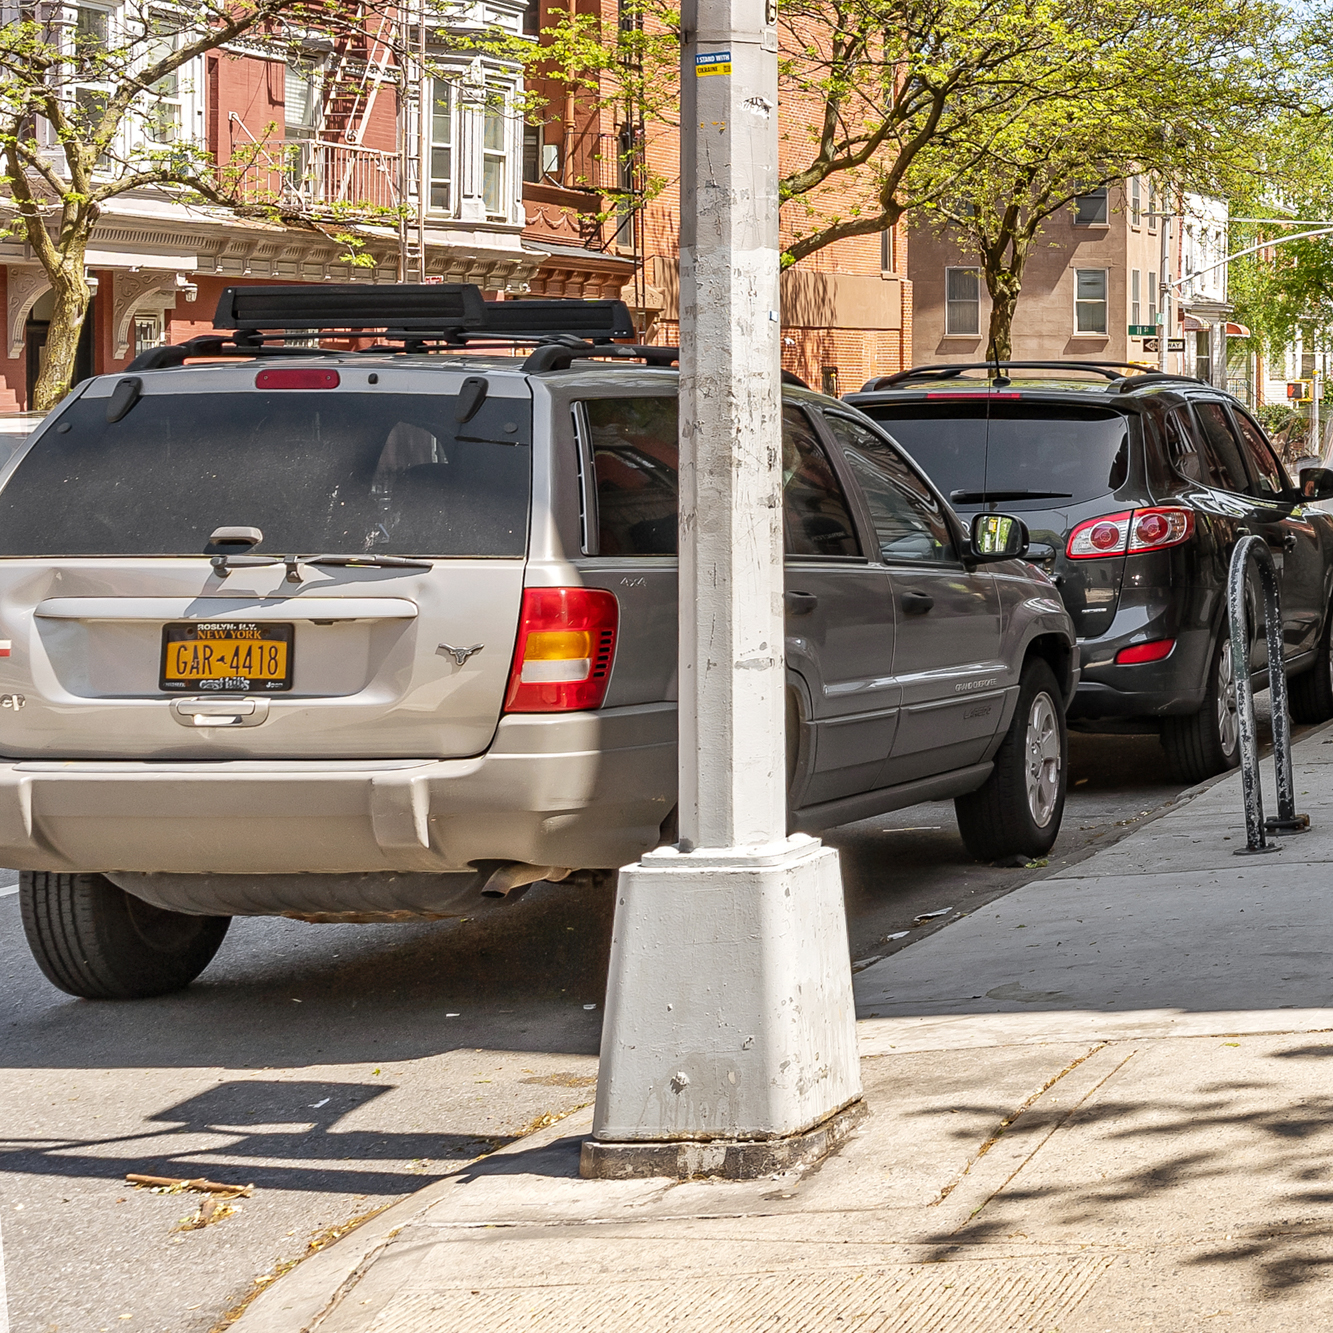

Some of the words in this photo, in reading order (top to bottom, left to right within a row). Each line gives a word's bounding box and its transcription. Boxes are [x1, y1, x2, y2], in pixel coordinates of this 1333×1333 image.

[197, 630, 227, 639] NEW
[230, 630, 262, 639] YORK
[176, 645, 213, 675] GAR
[230, 645, 279, 675] 4418
